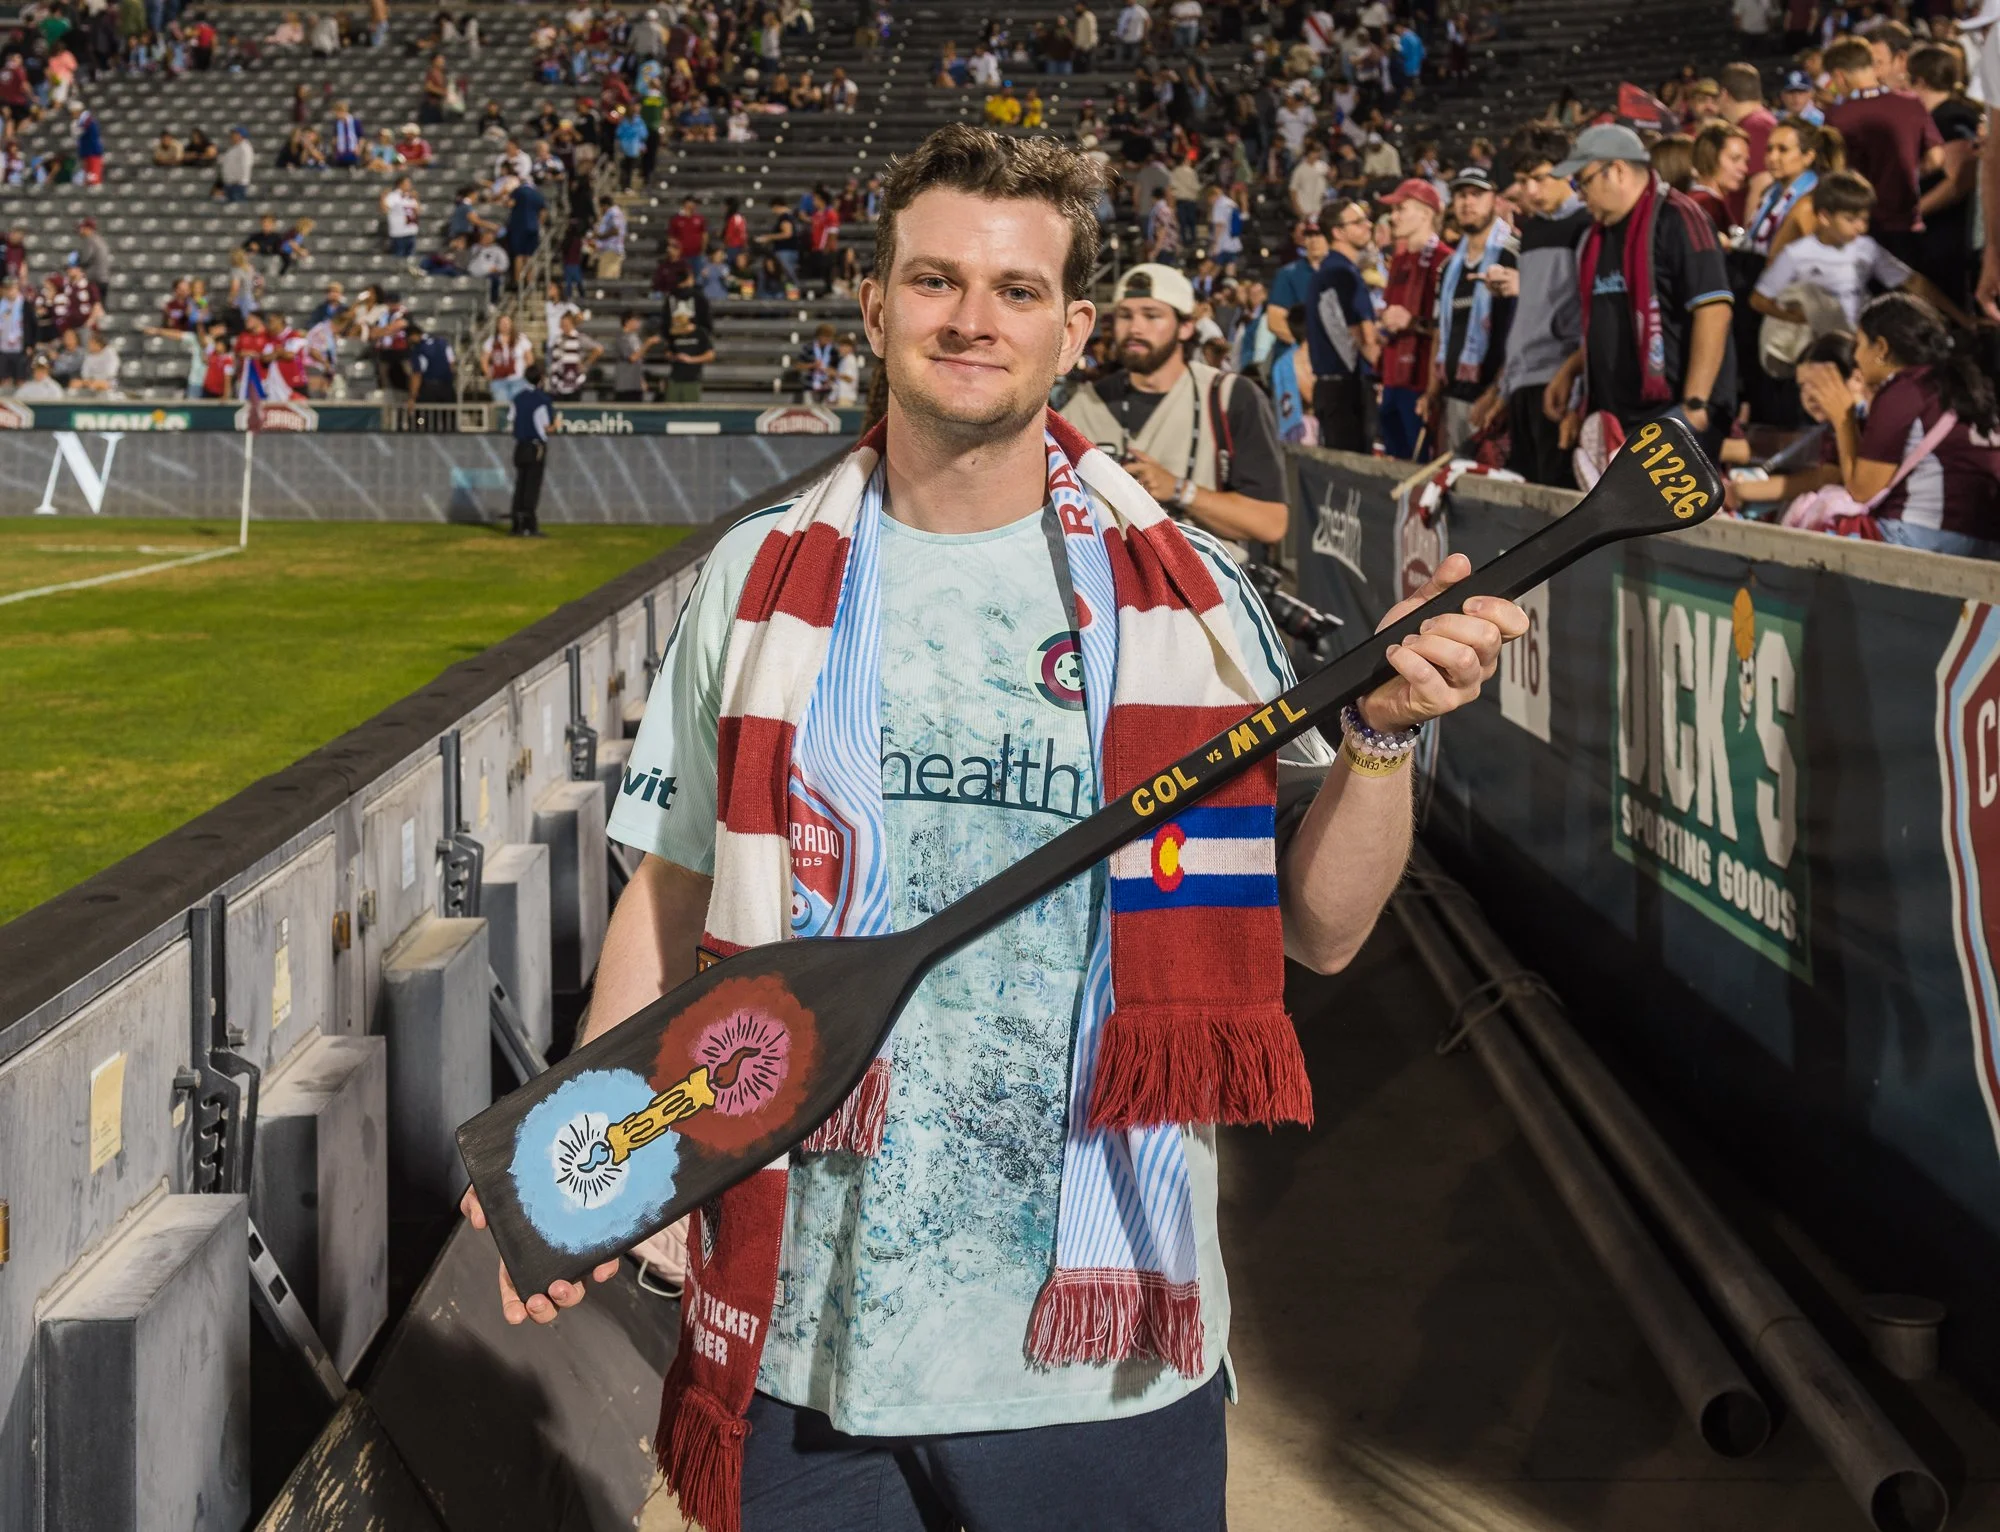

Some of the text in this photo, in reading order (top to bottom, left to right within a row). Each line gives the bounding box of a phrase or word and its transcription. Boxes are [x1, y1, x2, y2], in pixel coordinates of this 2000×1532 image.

[33, 431, 126, 515] N
[1131, 766, 1199, 817] COL
[1228, 699, 1308, 759] MTL
[1617, 586, 1798, 869] DICK'S
[1621, 793, 1797, 941] SPORTING GOODS
[704, 1291, 760, 1348] TICKET
